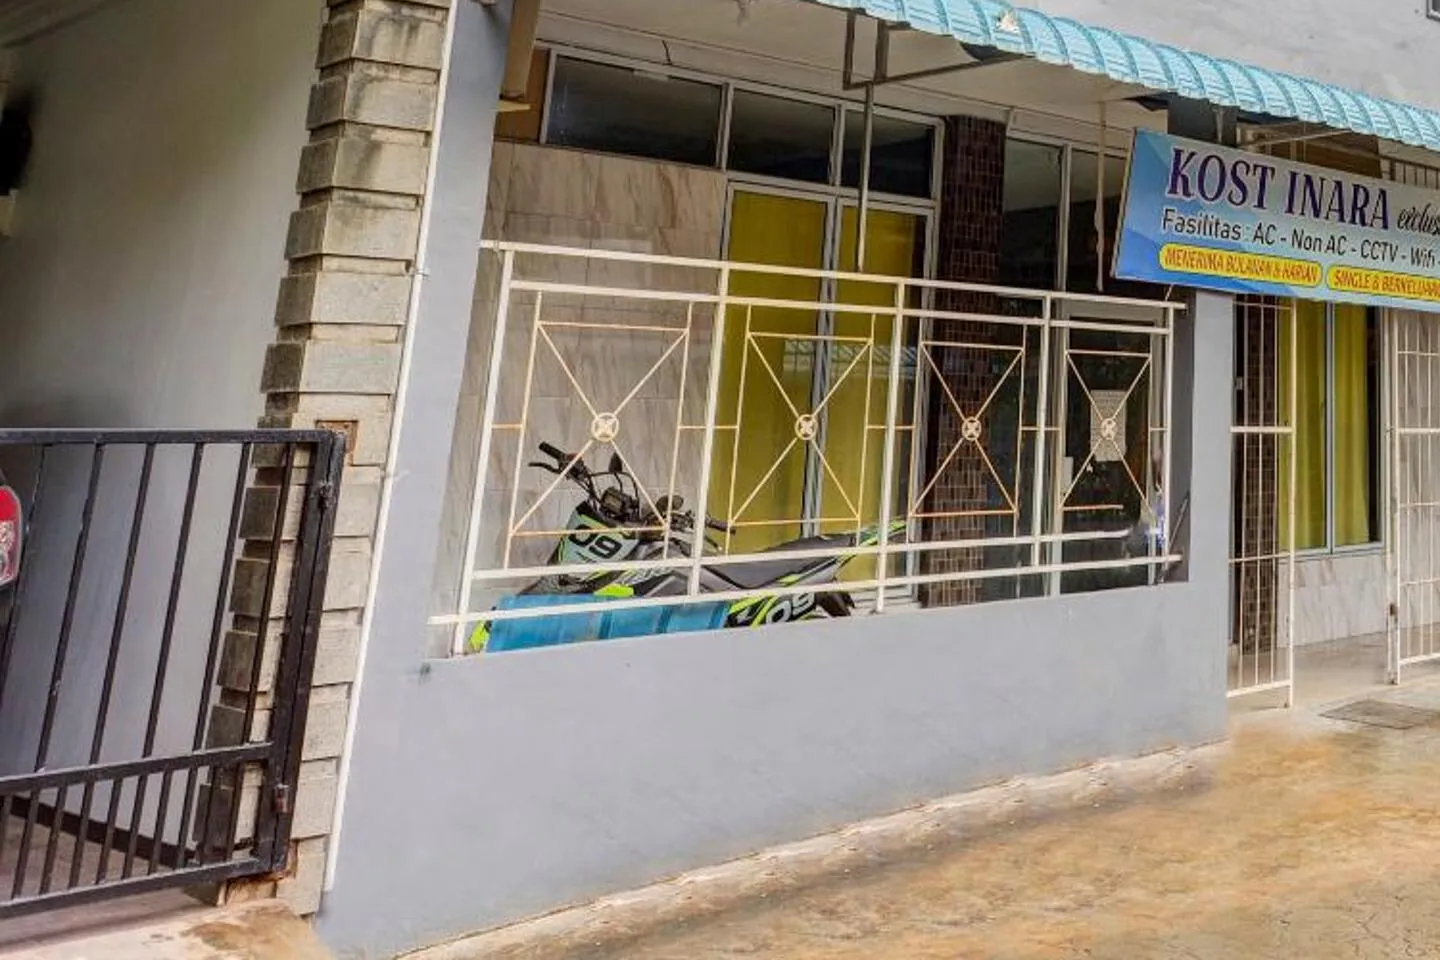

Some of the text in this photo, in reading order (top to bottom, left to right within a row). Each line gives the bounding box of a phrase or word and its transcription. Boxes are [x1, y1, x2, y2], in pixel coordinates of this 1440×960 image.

[1167, 147, 1389, 229] KOST INARA
[1162, 208, 1241, 240] Fasilitas
[1253, 222, 1277, 245] AC
[1291, 228, 1322, 253] Non
[1326, 234, 1347, 256] AC
[1360, 239, 1399, 262] CCTV
